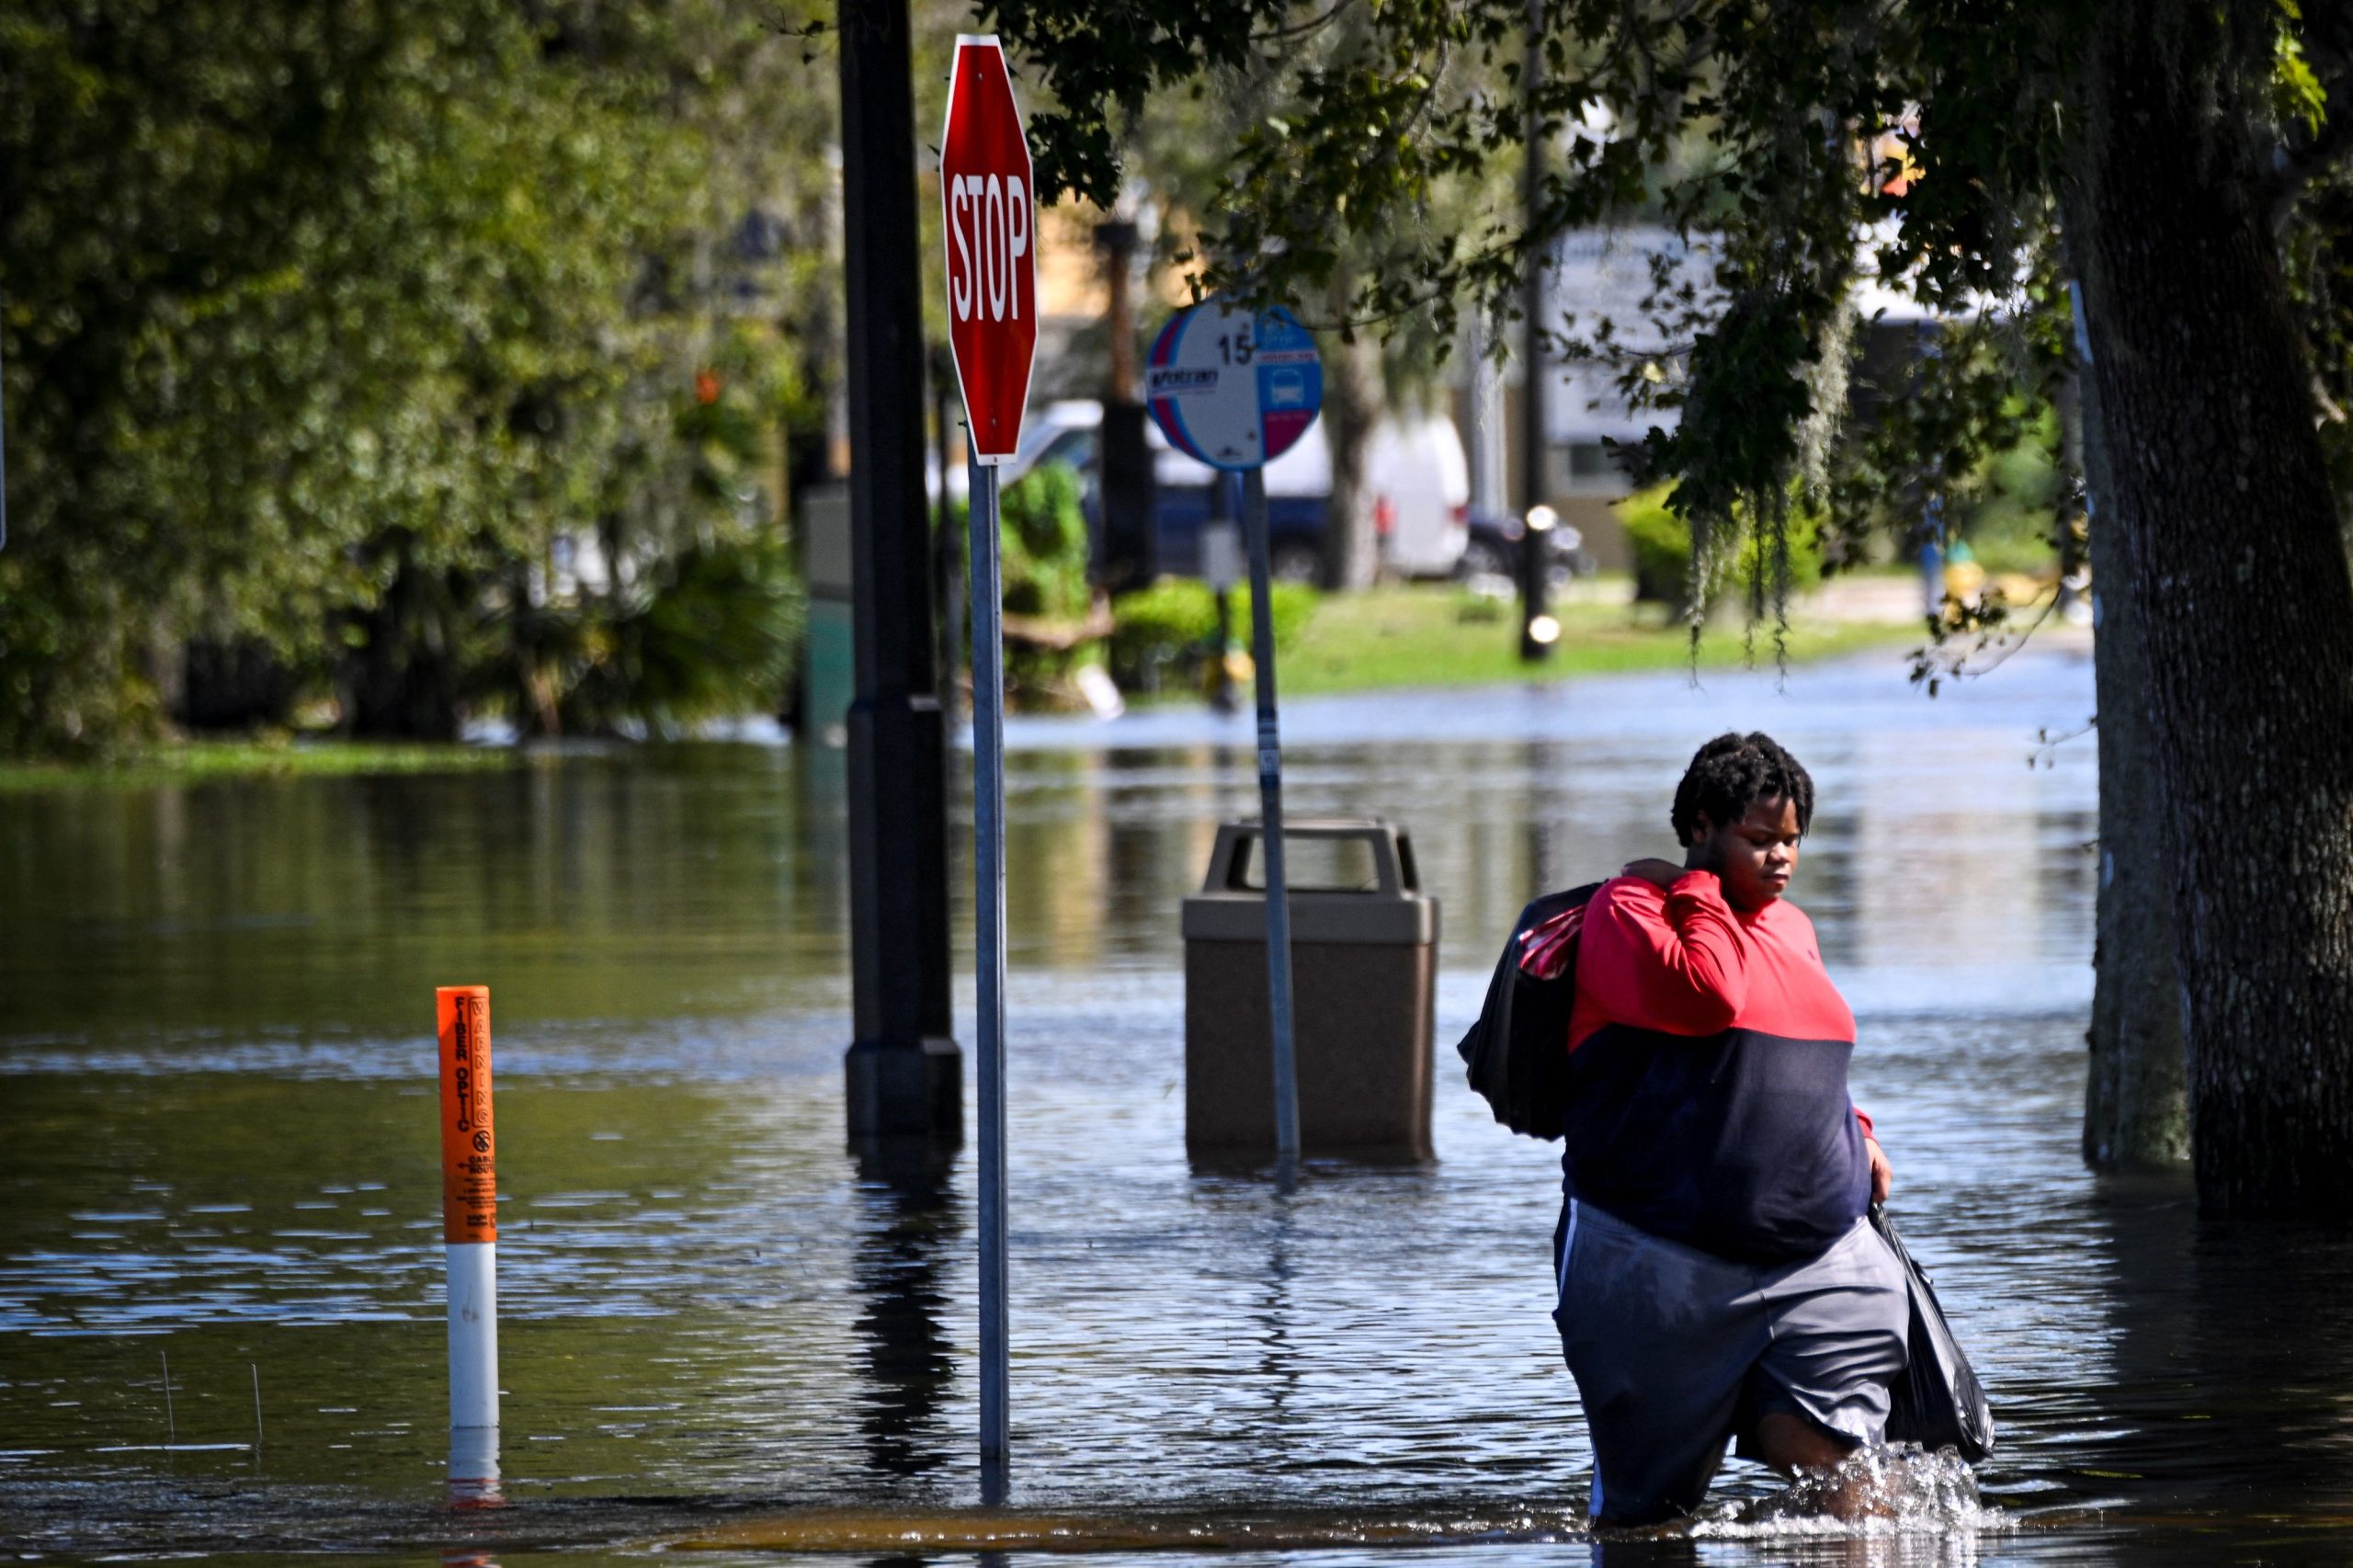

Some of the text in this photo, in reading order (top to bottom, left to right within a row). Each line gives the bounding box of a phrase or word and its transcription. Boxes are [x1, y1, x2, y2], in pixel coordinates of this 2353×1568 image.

[950, 173, 1028, 323] STOP
[1218, 335, 1253, 366] 15
[456, 997, 469, 1131] FIBER OPTIC
[472, 1001, 488, 1123] WARNING
